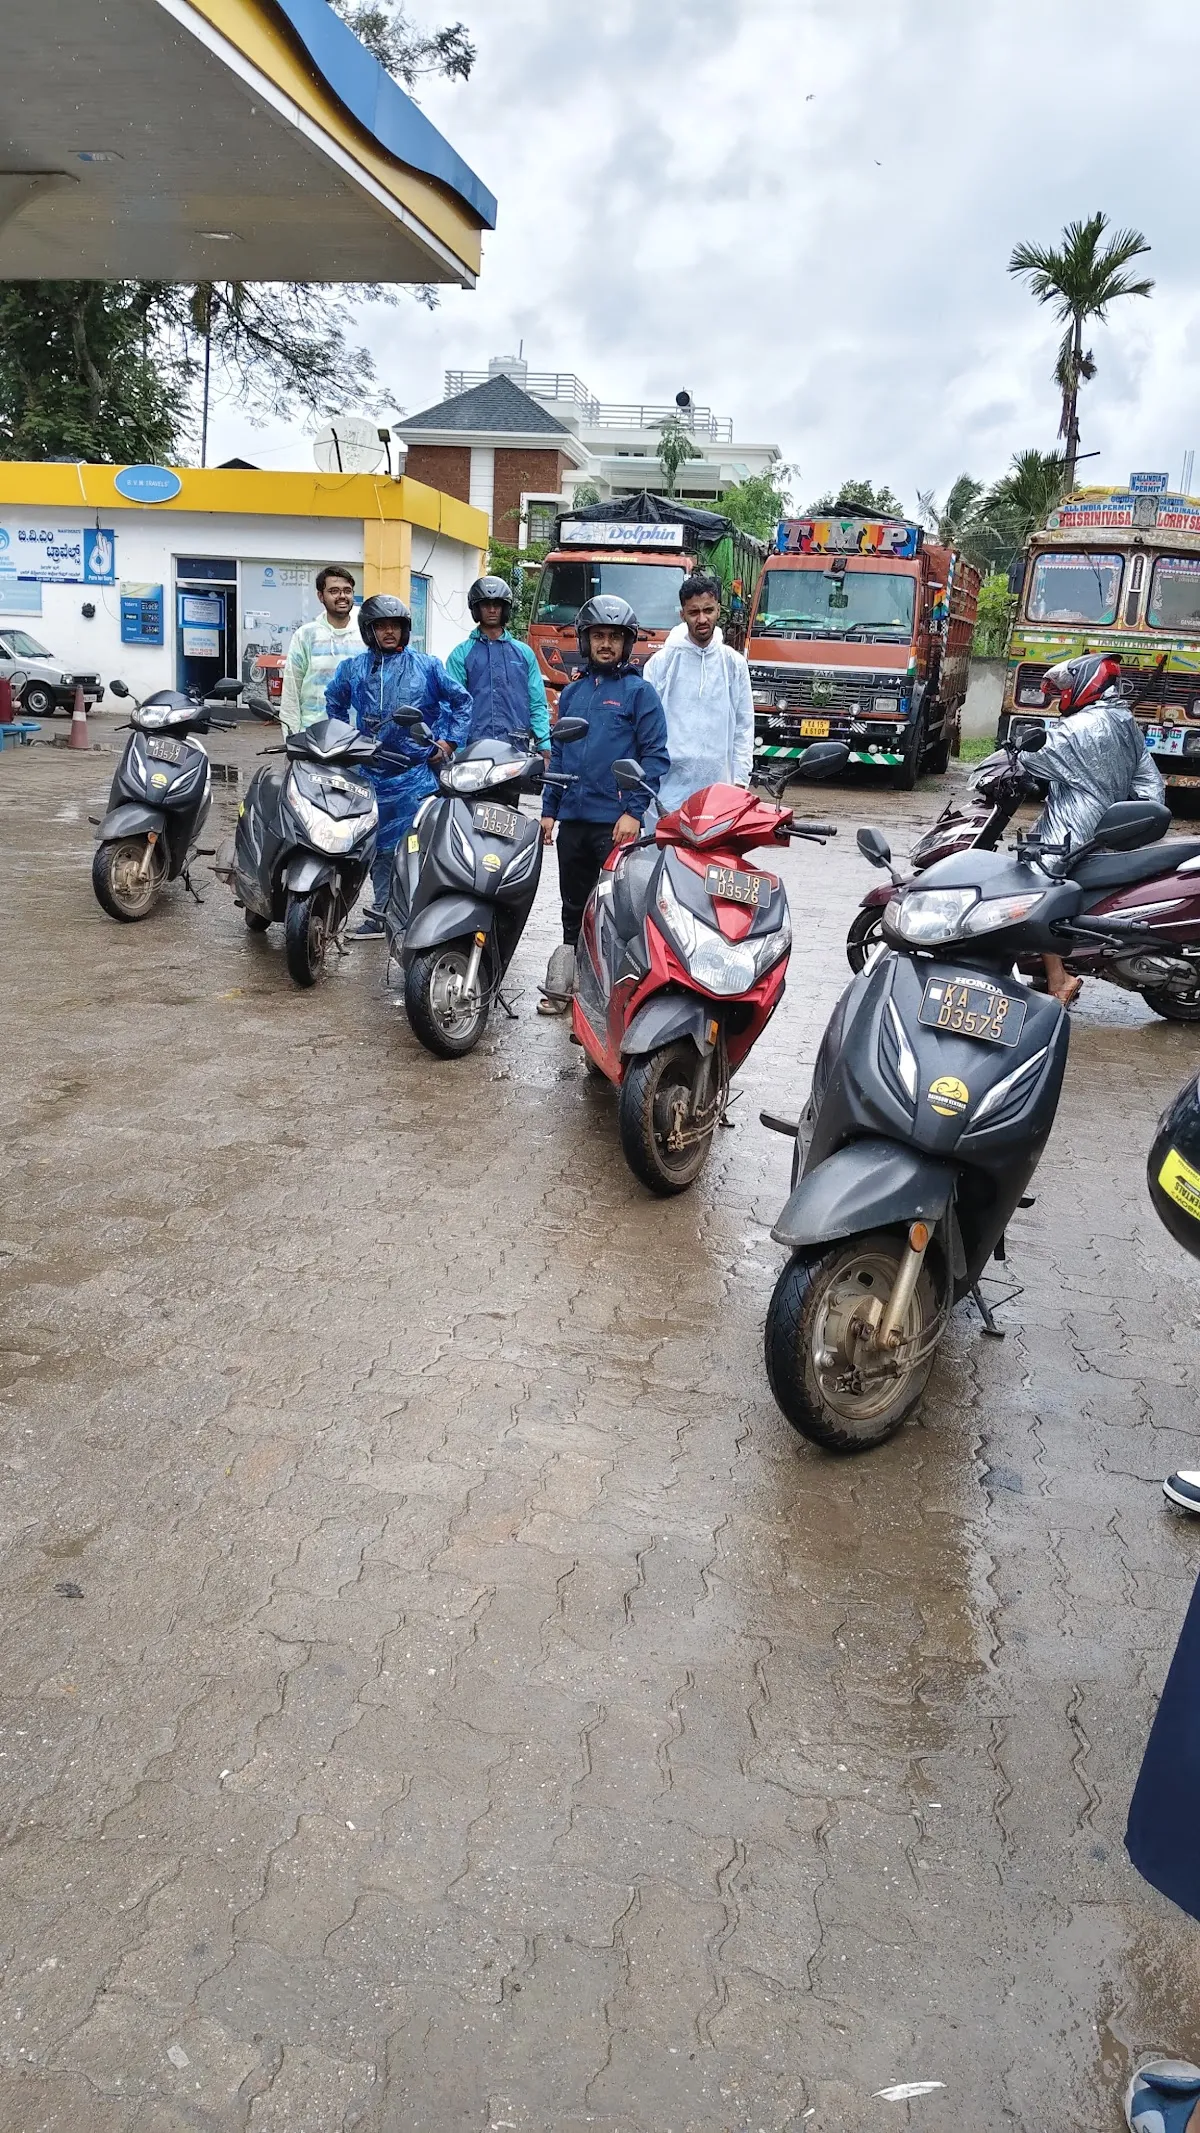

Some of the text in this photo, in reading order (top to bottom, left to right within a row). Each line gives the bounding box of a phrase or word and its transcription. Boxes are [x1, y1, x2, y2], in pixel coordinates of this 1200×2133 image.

[1135, 485, 1161, 493] PERMIT
[1076, 511, 1132, 526] SRINIVASA
[1157, 512, 1190, 529] LORRY
[608, 525, 676, 544] Dolphin
[813, 670, 835, 678] TATA
[154, 740, 165, 749] KA
[483, 807, 518, 827] KA 18
[481, 818, 517, 837] D3574
[719, 868, 760, 891] KA 18
[717, 882, 760, 904] D3576
[954, 976, 1004, 996] HONDA
[943, 984, 1009, 1019] KA 18
[937, 1004, 1005, 1040] D3575
